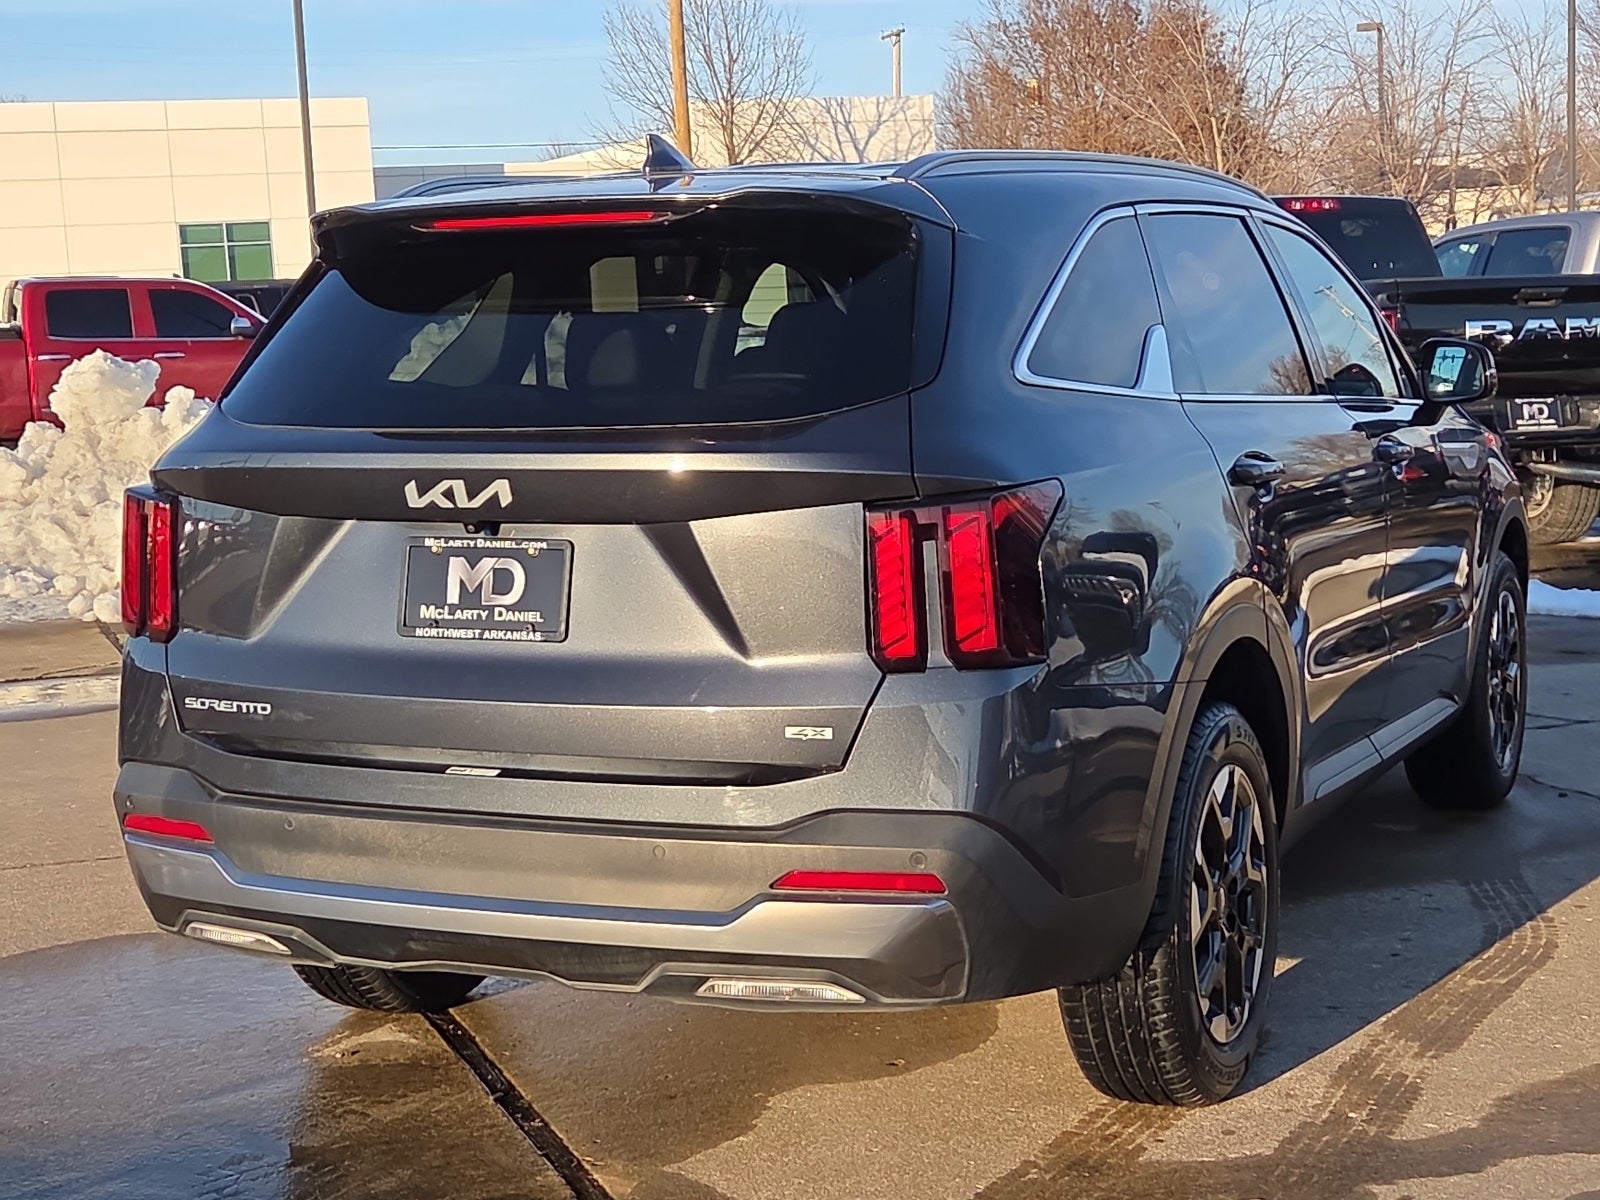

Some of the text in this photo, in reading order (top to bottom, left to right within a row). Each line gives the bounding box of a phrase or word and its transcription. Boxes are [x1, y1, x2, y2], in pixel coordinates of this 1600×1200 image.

[404, 479, 513, 509] KIA
[446, 556, 526, 606] MD
[493, 607, 545, 623] DANIEL
[415, 627, 543, 641] NORTHWEST ARKANSAS
[184, 697, 272, 715] SORENTO
